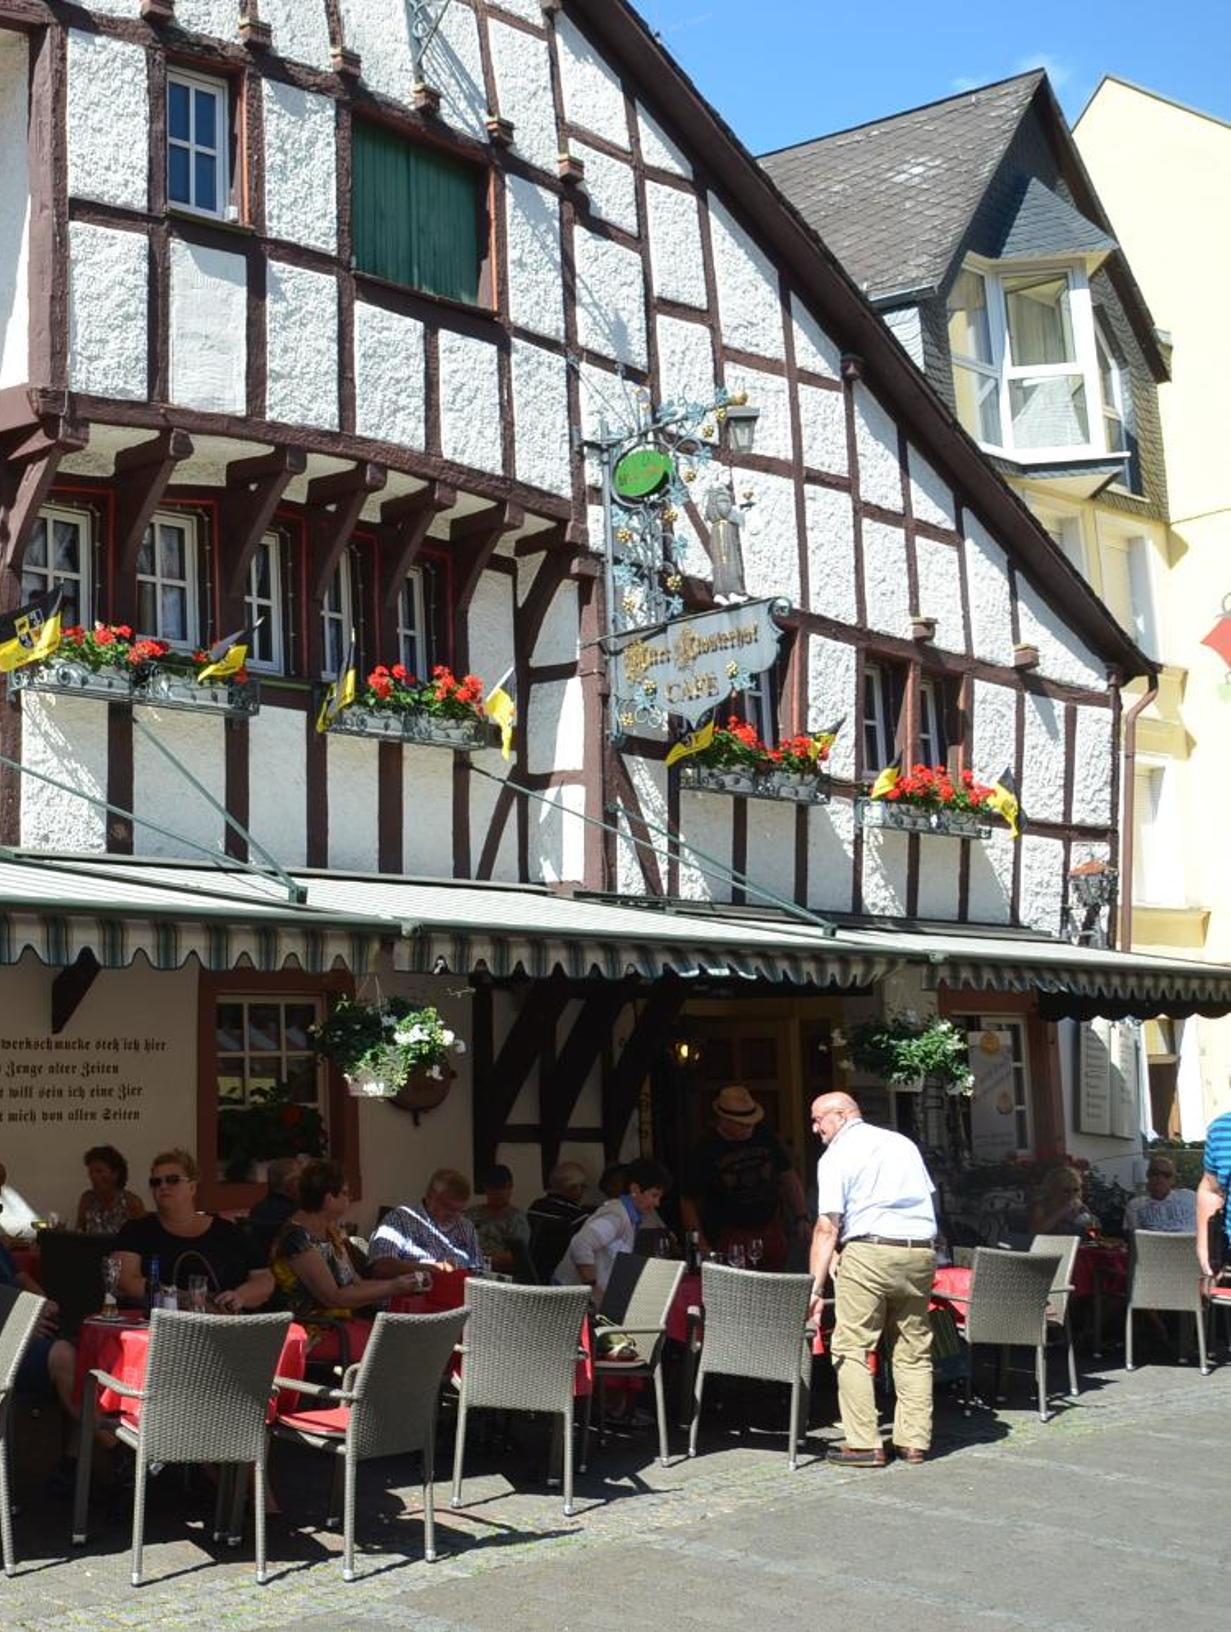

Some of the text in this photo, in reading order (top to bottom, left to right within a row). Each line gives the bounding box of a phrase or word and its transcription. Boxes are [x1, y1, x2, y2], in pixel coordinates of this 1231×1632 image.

[123, 1038, 141, 1052] ich
[143, 1037, 167, 1054] hier
[48, 1061, 78, 1075] alter
[80, 1060, 119, 1078] Zeiten
[8, 1084, 34, 1099] will
[38, 1085, 64, 1099] sein
[67, 1085, 86, 1100] ich
[89, 1083, 115, 1098] eine
[7, 1108, 37, 1123] mich
[41, 1109, 64, 1122] von
[67, 1107, 97, 1121] allen
[102, 1106, 140, 1121] Seiten
